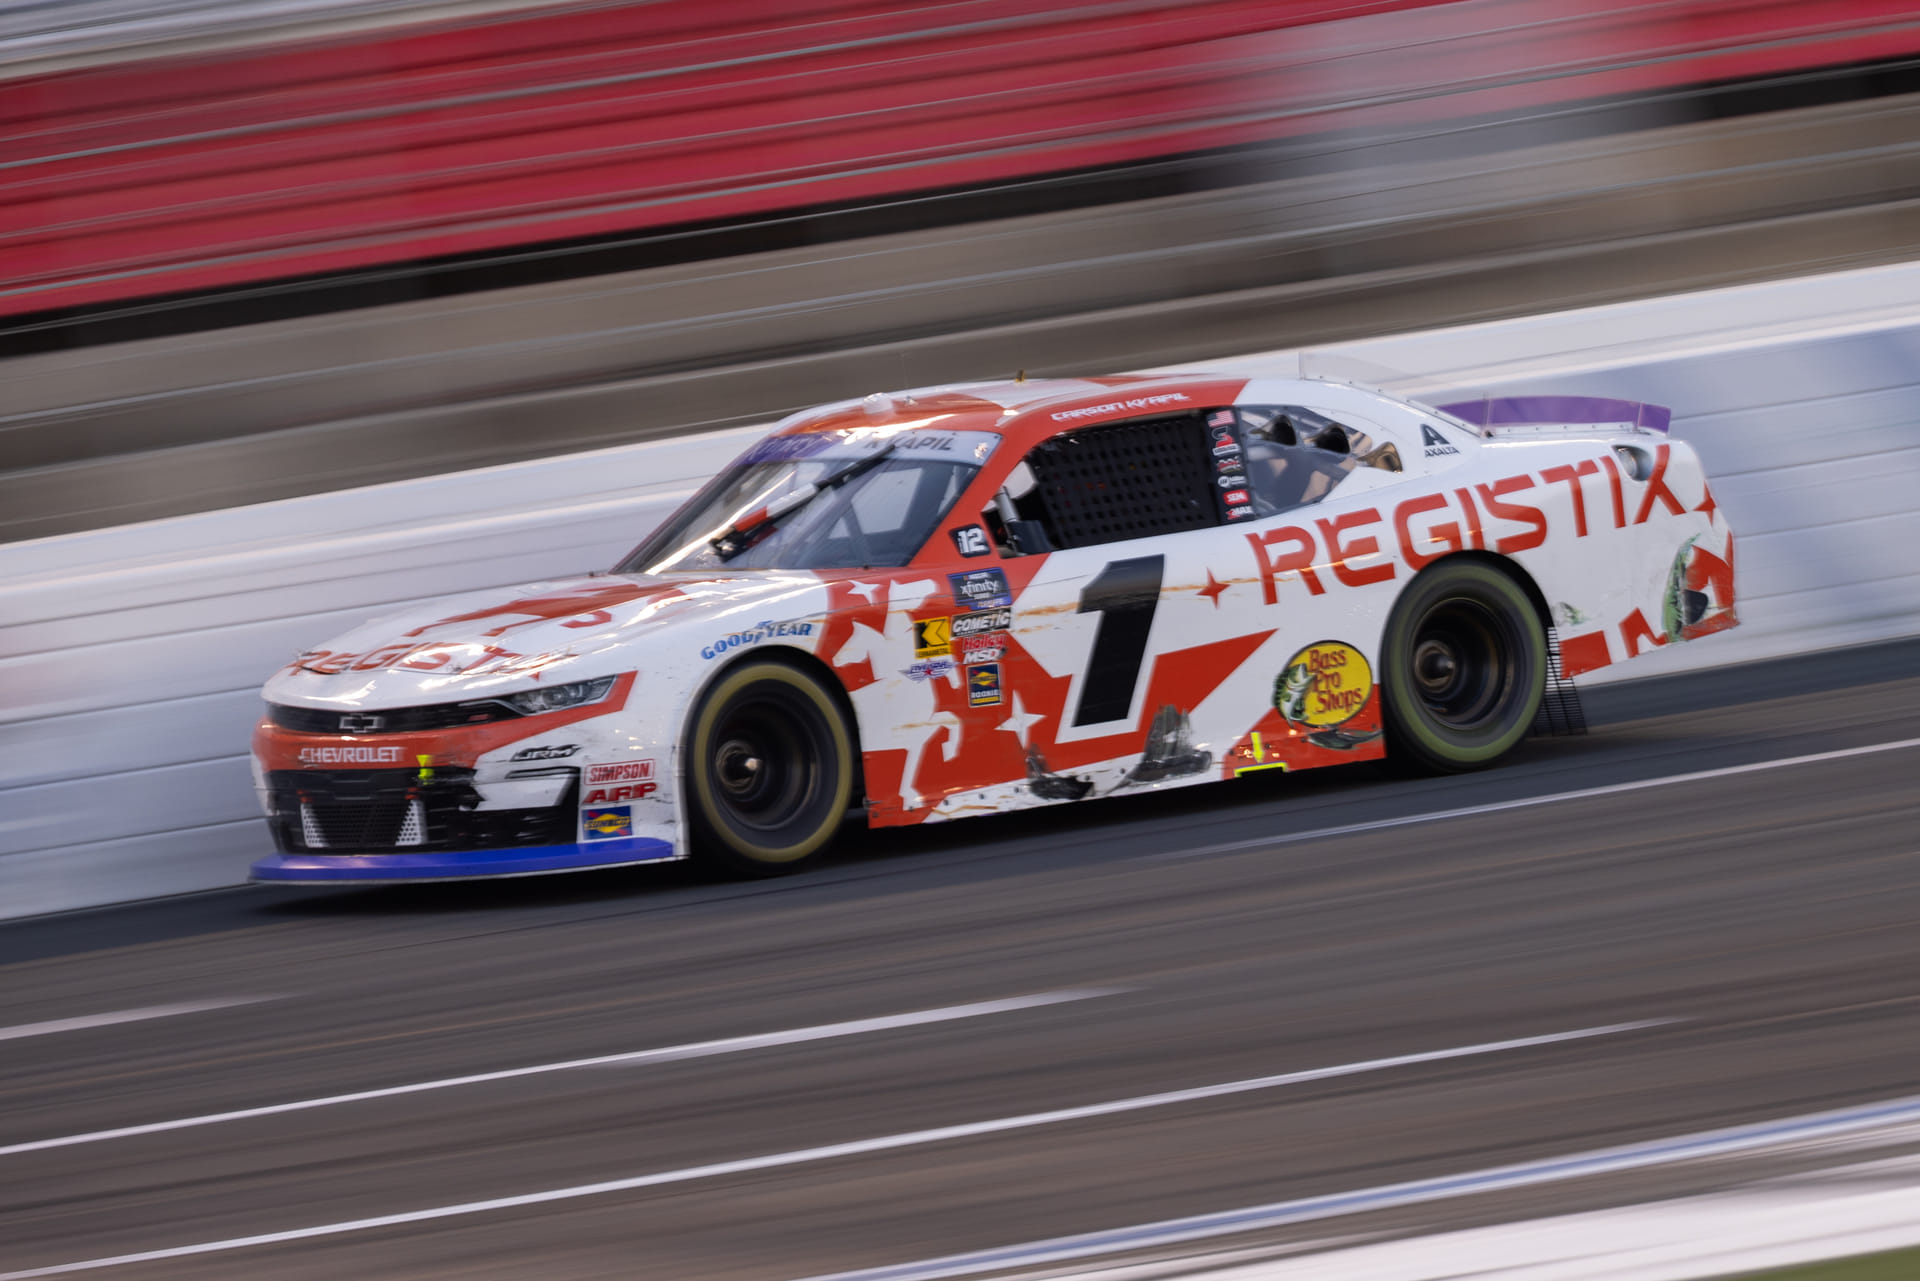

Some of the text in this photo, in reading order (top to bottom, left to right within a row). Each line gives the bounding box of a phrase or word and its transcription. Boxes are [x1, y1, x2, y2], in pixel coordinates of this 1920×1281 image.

[1050, 402, 1124, 421] CARSON
[1244, 443, 1687, 606] REGISTIX
[957, 527, 987, 554] 12
[960, 579, 1000, 598] xfinity
[952, 611, 1011, 633] COMETIC
[701, 620, 812, 660] GOODYEAR
[963, 633, 1007, 653] Holley
[1071, 553, 1165, 728] 1
[962, 648, 1001, 664] MSD
[1309, 649, 1347, 672] Bass
[1314, 671, 1342, 693] Pro
[1314, 688, 1363, 714] Shops
[300, 745, 402, 763] CHEVROLET
[589, 763, 650, 782] SIMPSON
[583, 782, 657, 803] ARP
